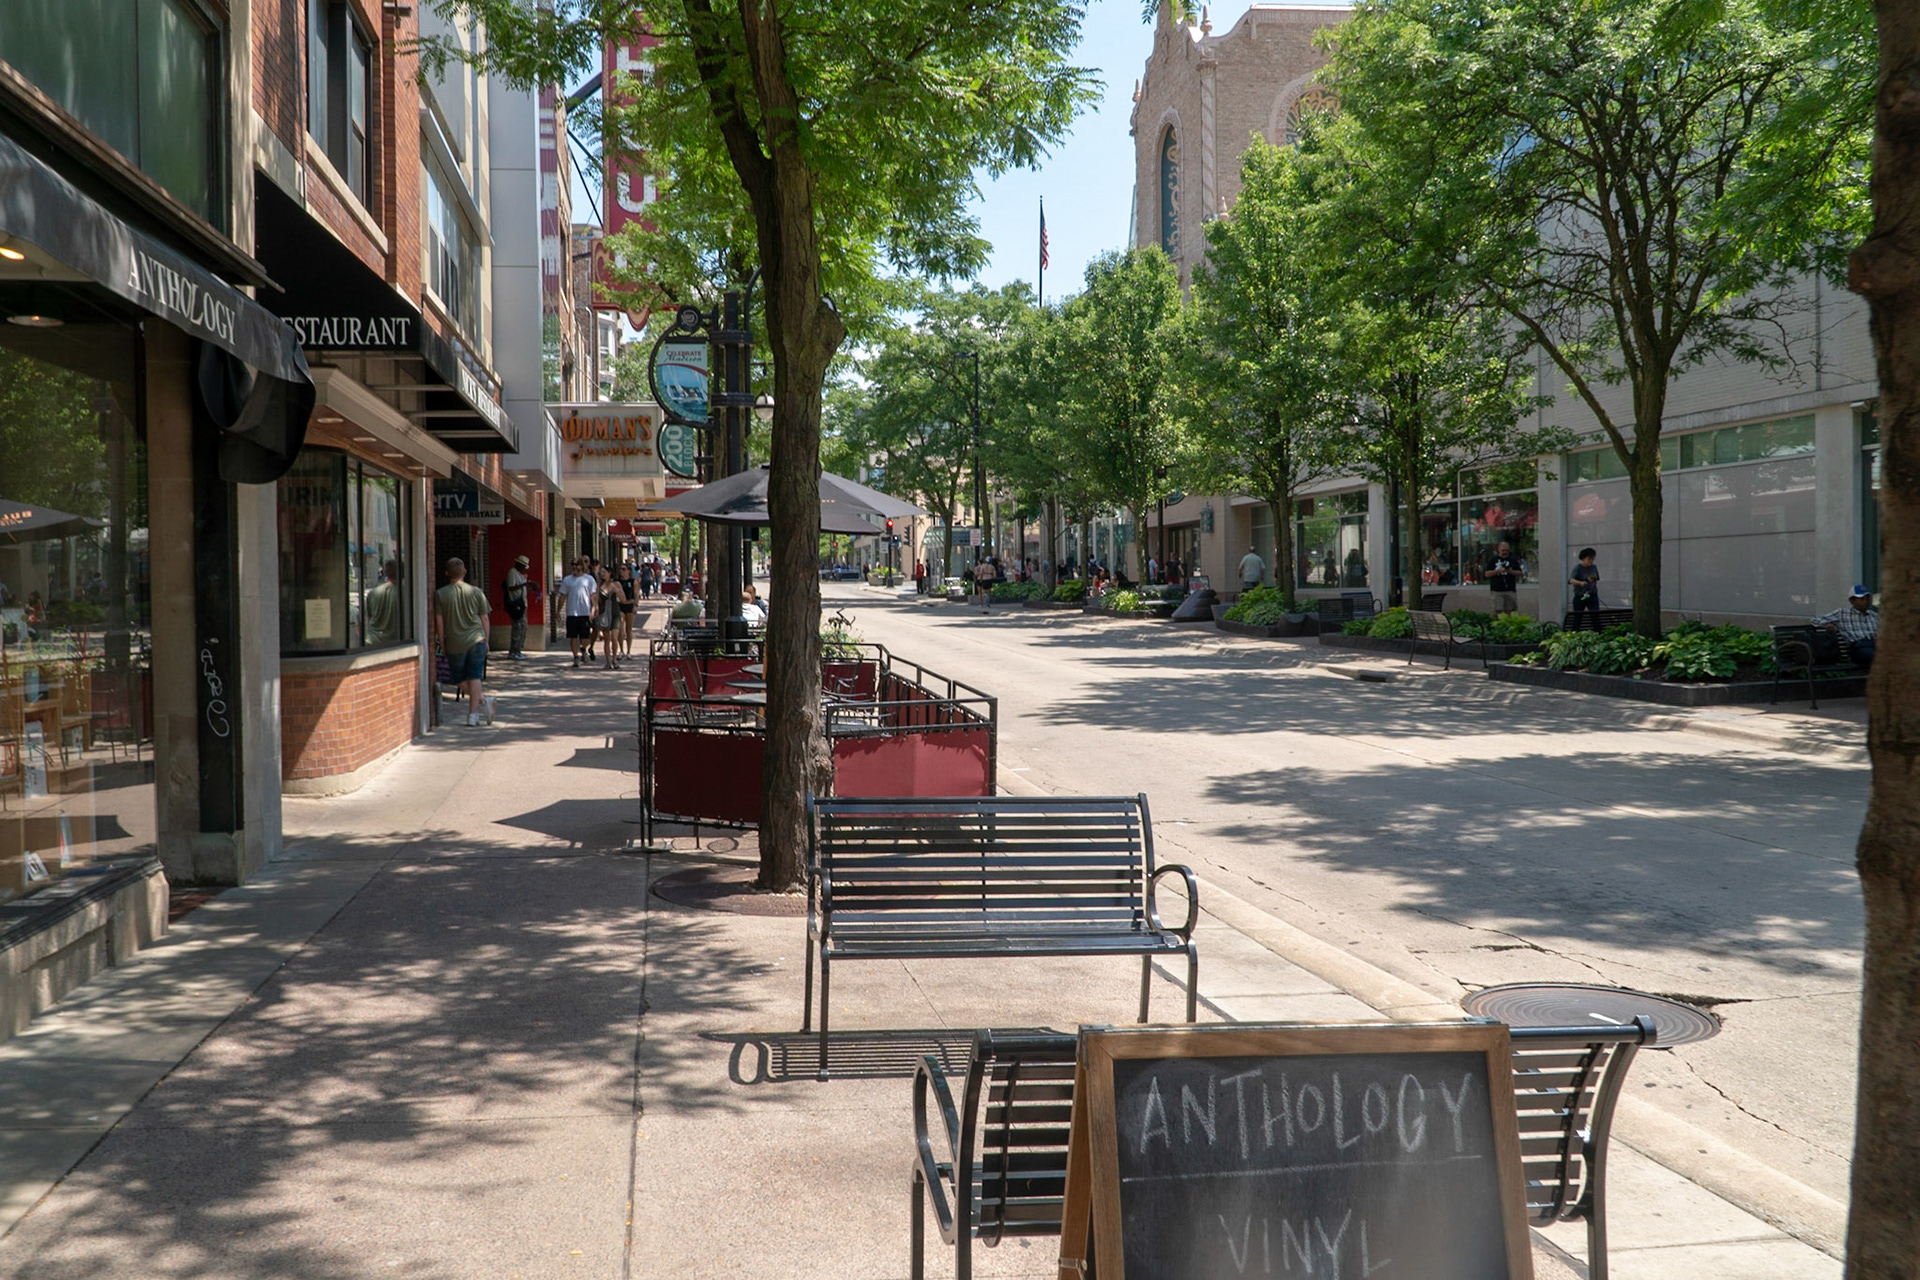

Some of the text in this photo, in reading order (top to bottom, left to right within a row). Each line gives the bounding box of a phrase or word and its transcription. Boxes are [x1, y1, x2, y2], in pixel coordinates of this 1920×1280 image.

[126, 245, 236, 346] ANTHOLOGY
[563, 414, 653, 442] OODMAN'S
[665, 425, 683, 468] 200
[570, 442, 653, 460] jewelers
[683, 434, 693, 467] BLOCK
[1139, 1069, 1473, 1160] ANTHOLOGY
[1218, 1208, 1392, 1280] VINYL
